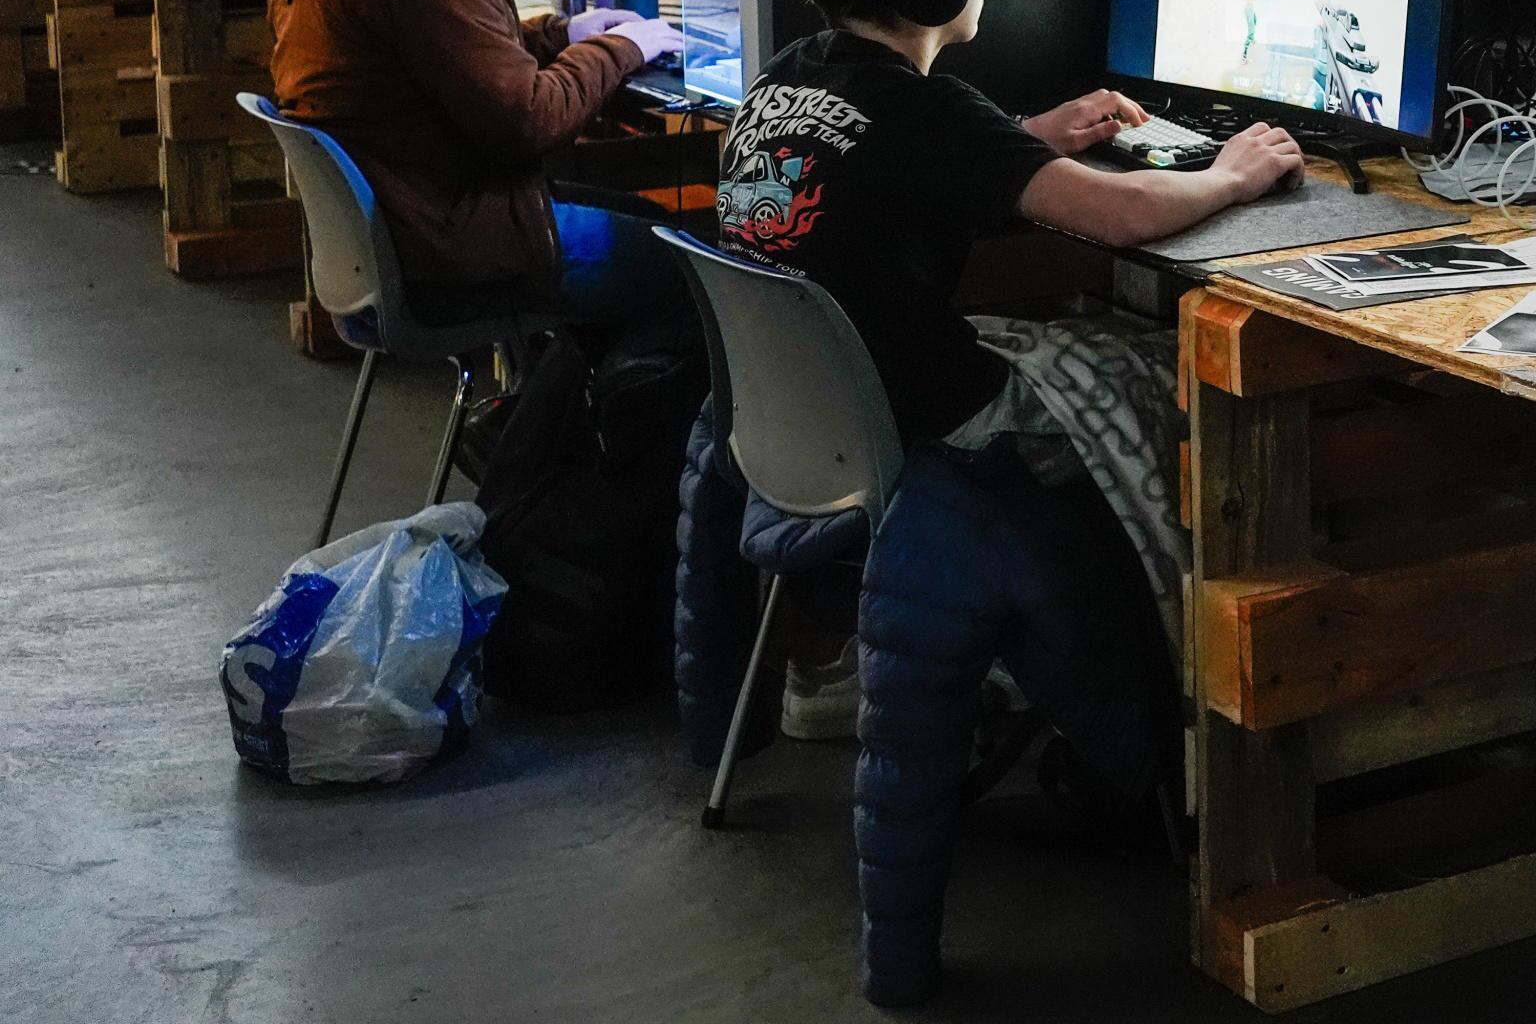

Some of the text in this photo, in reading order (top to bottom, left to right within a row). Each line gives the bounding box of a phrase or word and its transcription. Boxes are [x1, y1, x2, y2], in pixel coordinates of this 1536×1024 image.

[724, 74, 873, 152] EYSTREET
[728, 115, 857, 173] RACING TEAM
